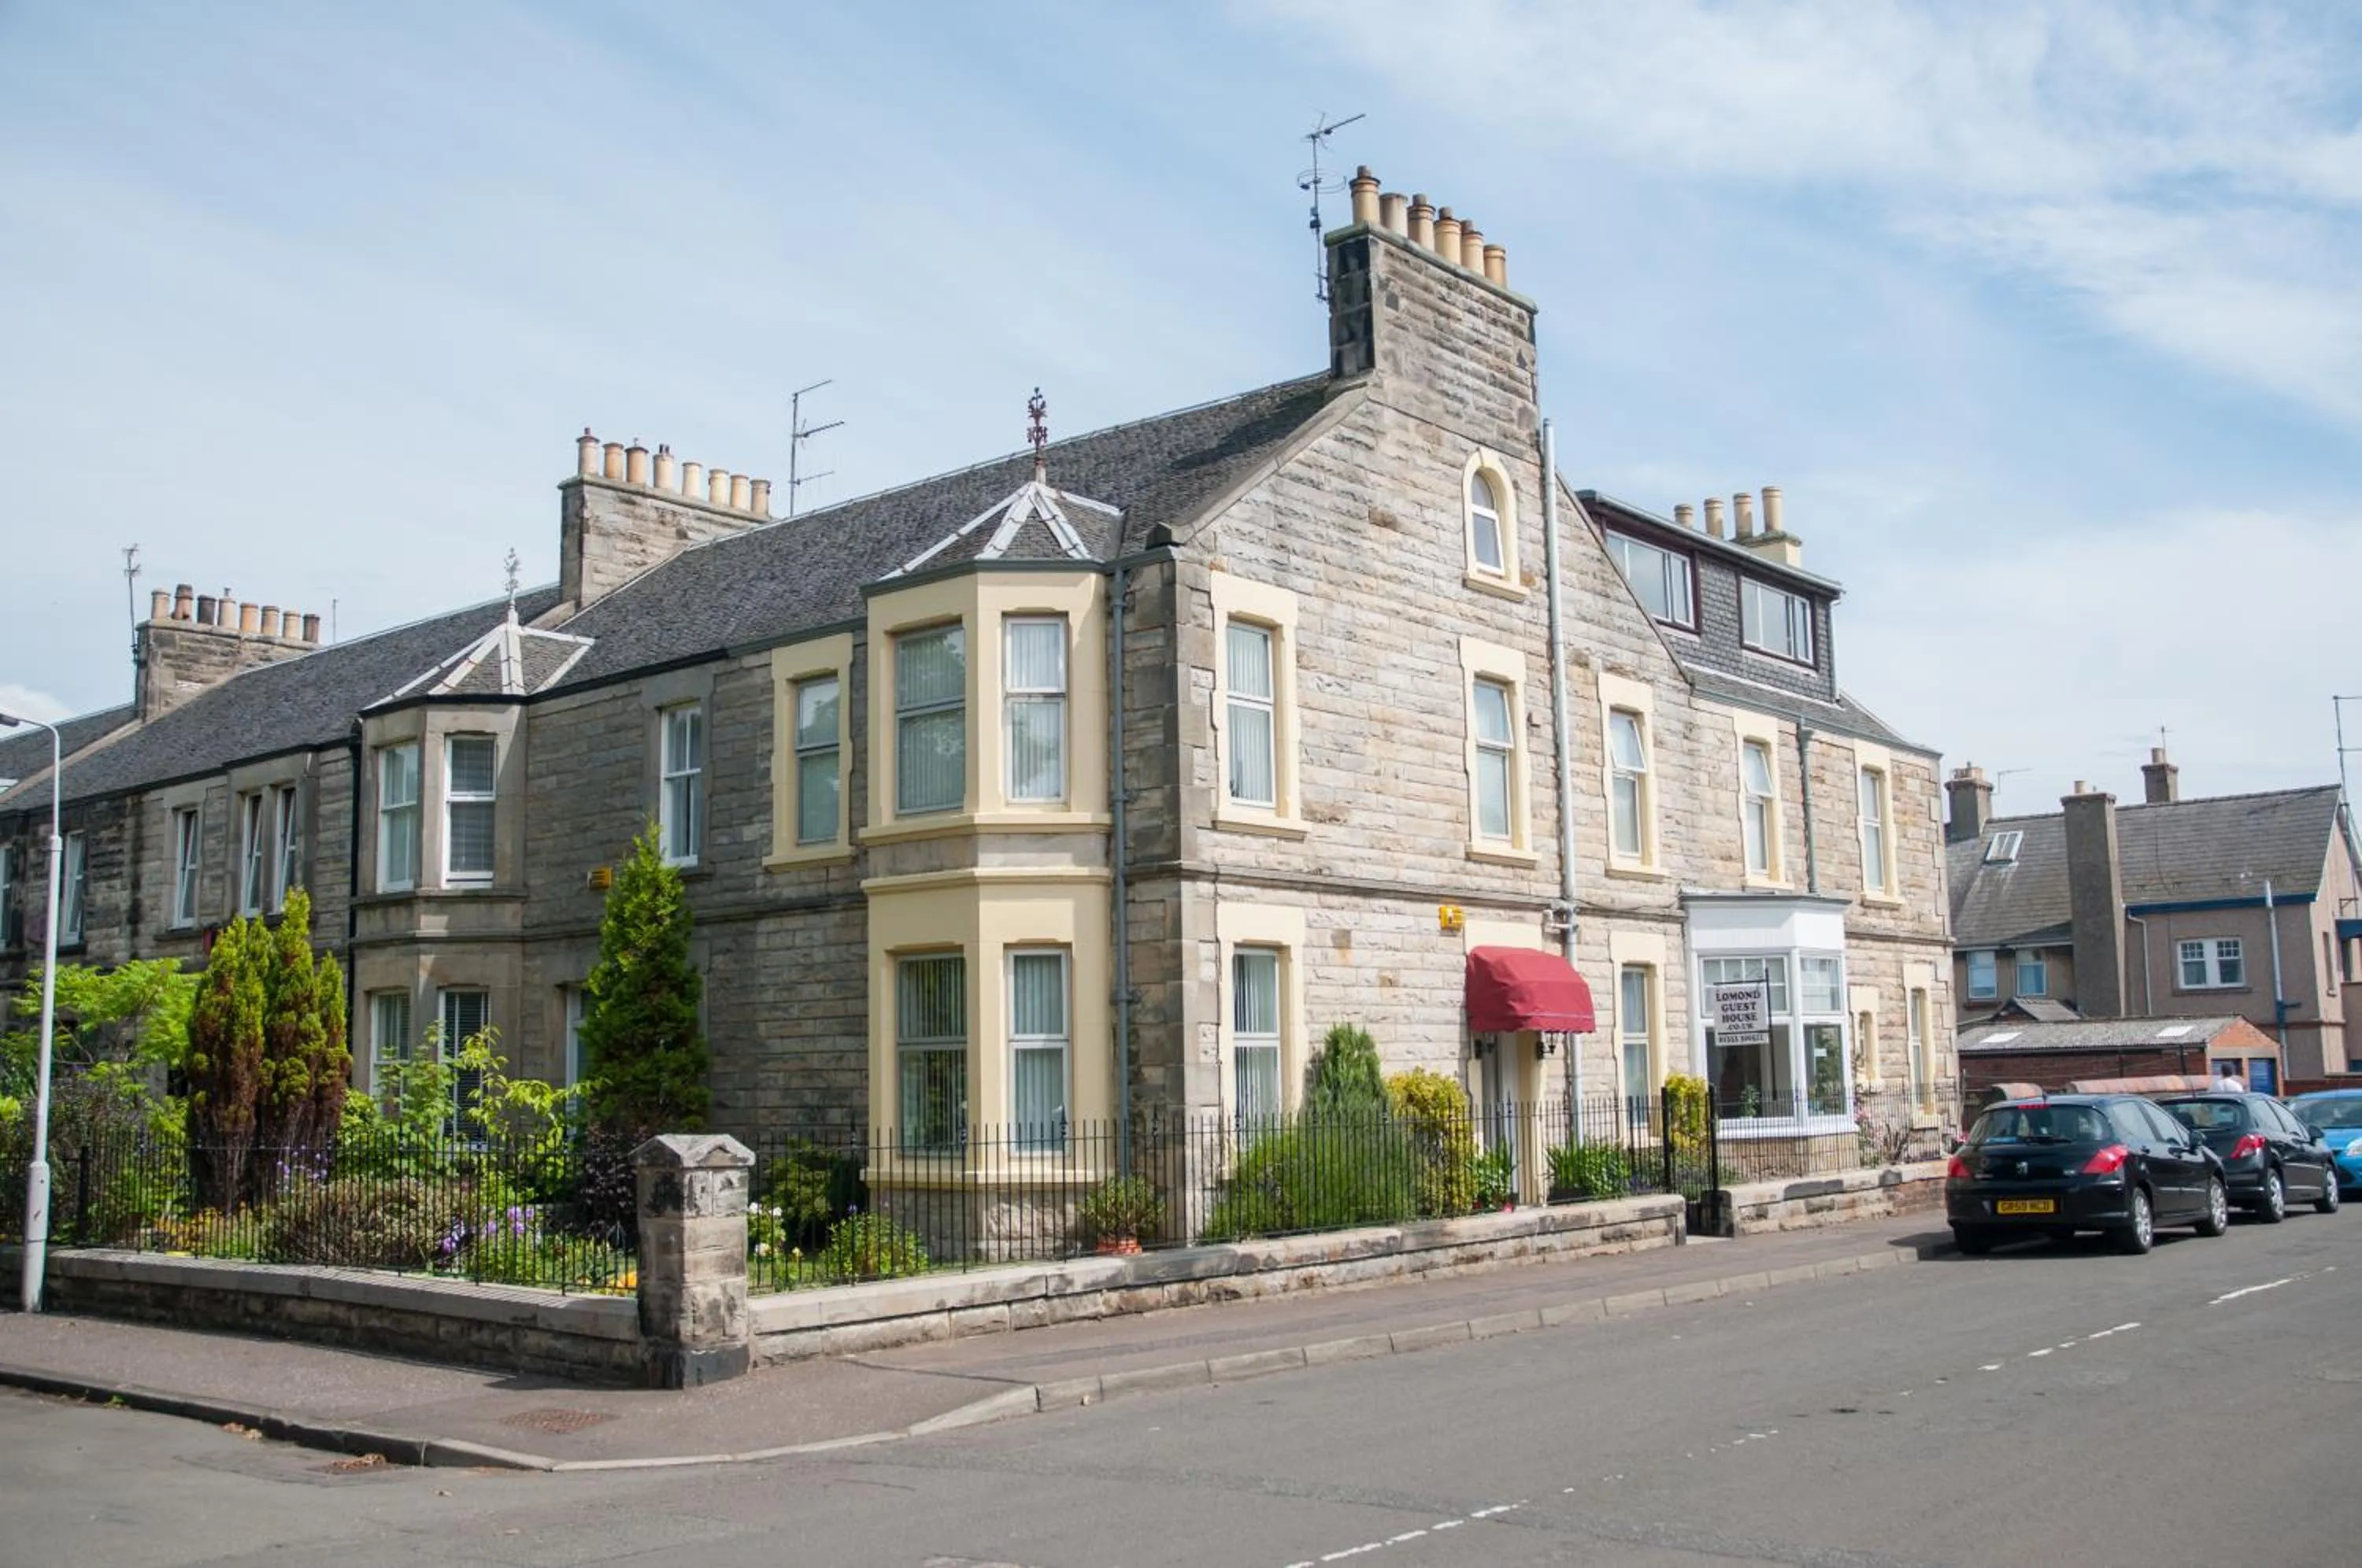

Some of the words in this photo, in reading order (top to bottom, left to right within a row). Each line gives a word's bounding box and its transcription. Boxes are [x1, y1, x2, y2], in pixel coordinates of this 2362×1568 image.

[1716, 991, 1761, 1002] LOMOND
[1721, 1001, 1757, 1012] GUEST
[1722, 1011, 1757, 1023] HOUSE
